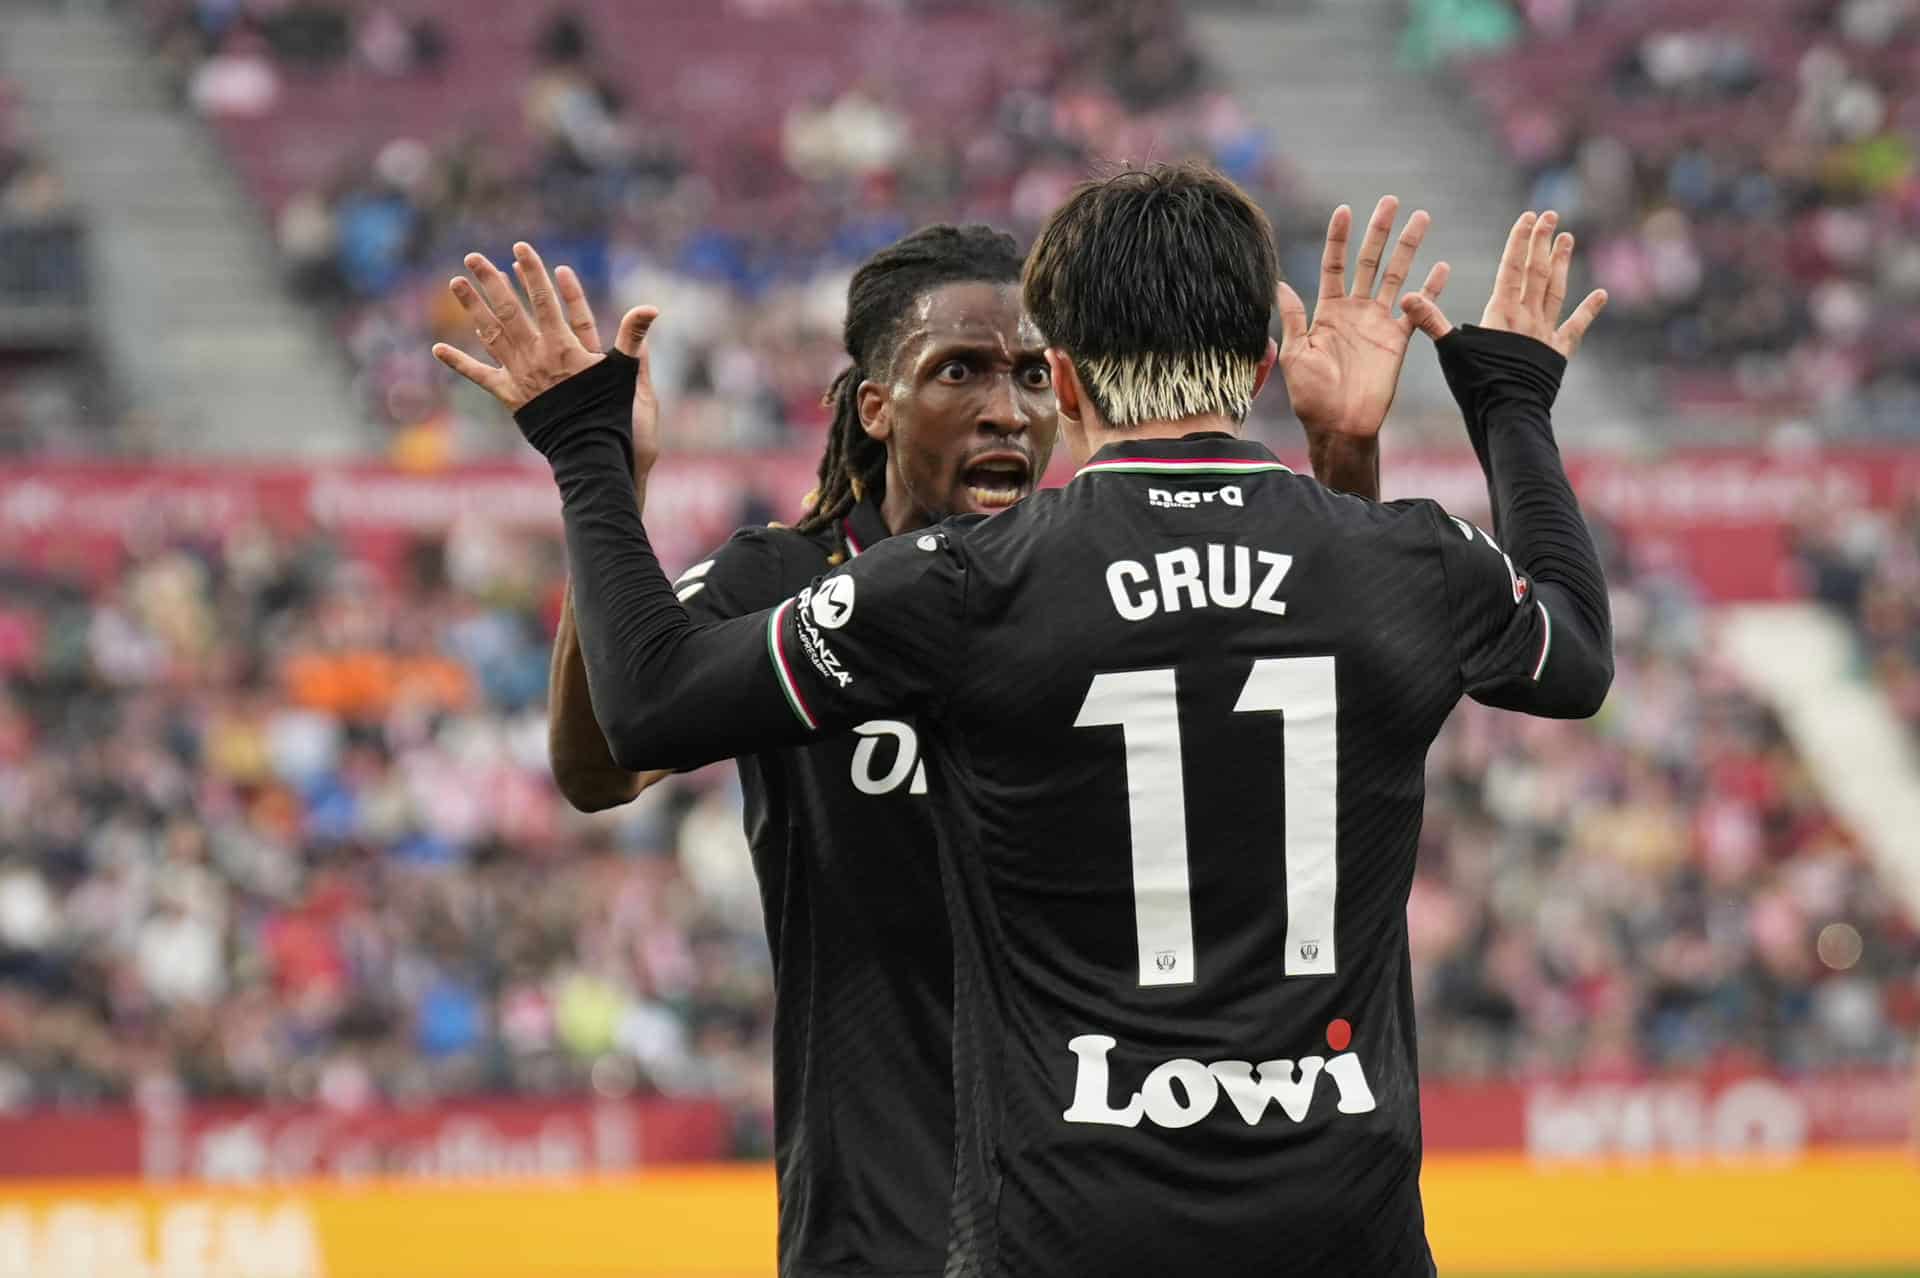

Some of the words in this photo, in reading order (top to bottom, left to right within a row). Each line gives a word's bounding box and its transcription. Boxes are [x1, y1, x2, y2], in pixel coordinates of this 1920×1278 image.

[1105, 542, 1293, 621] CRUZ
[1072, 655, 1338, 987] 11
[1063, 1018, 1377, 1129] Lowi
